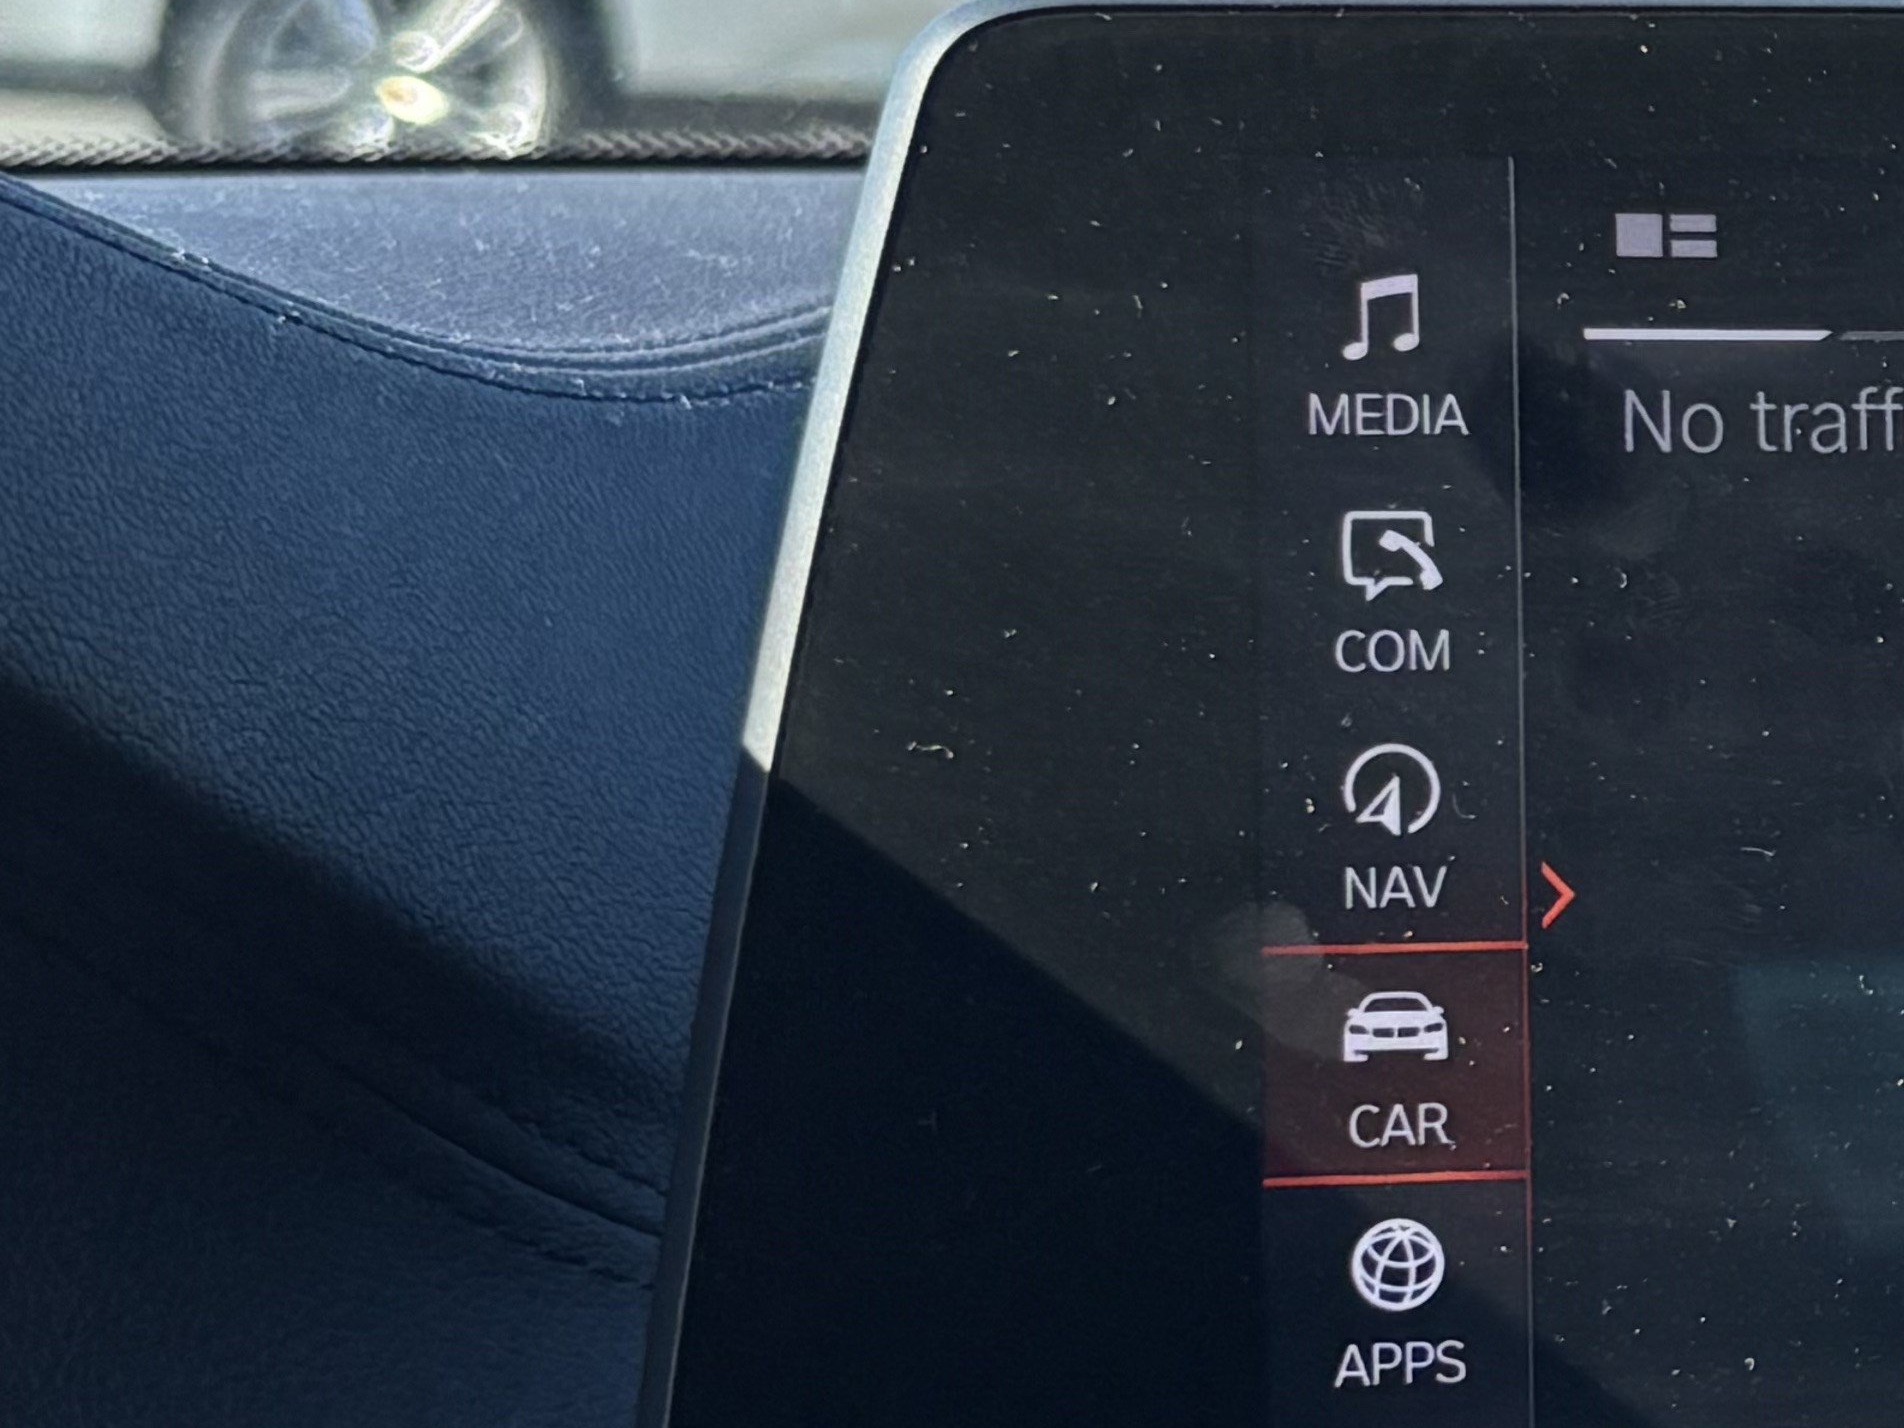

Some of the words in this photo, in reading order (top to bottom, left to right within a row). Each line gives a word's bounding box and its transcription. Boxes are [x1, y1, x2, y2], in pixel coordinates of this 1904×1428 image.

[1307, 392, 1470, 436] MEDIA
[1622, 388, 1725, 454] No
[1333, 629, 1452, 674] COM
[1343, 865, 1448, 911] NAV
[1348, 1102, 1451, 1148] CAR
[1333, 1340, 1468, 1388] APPS
